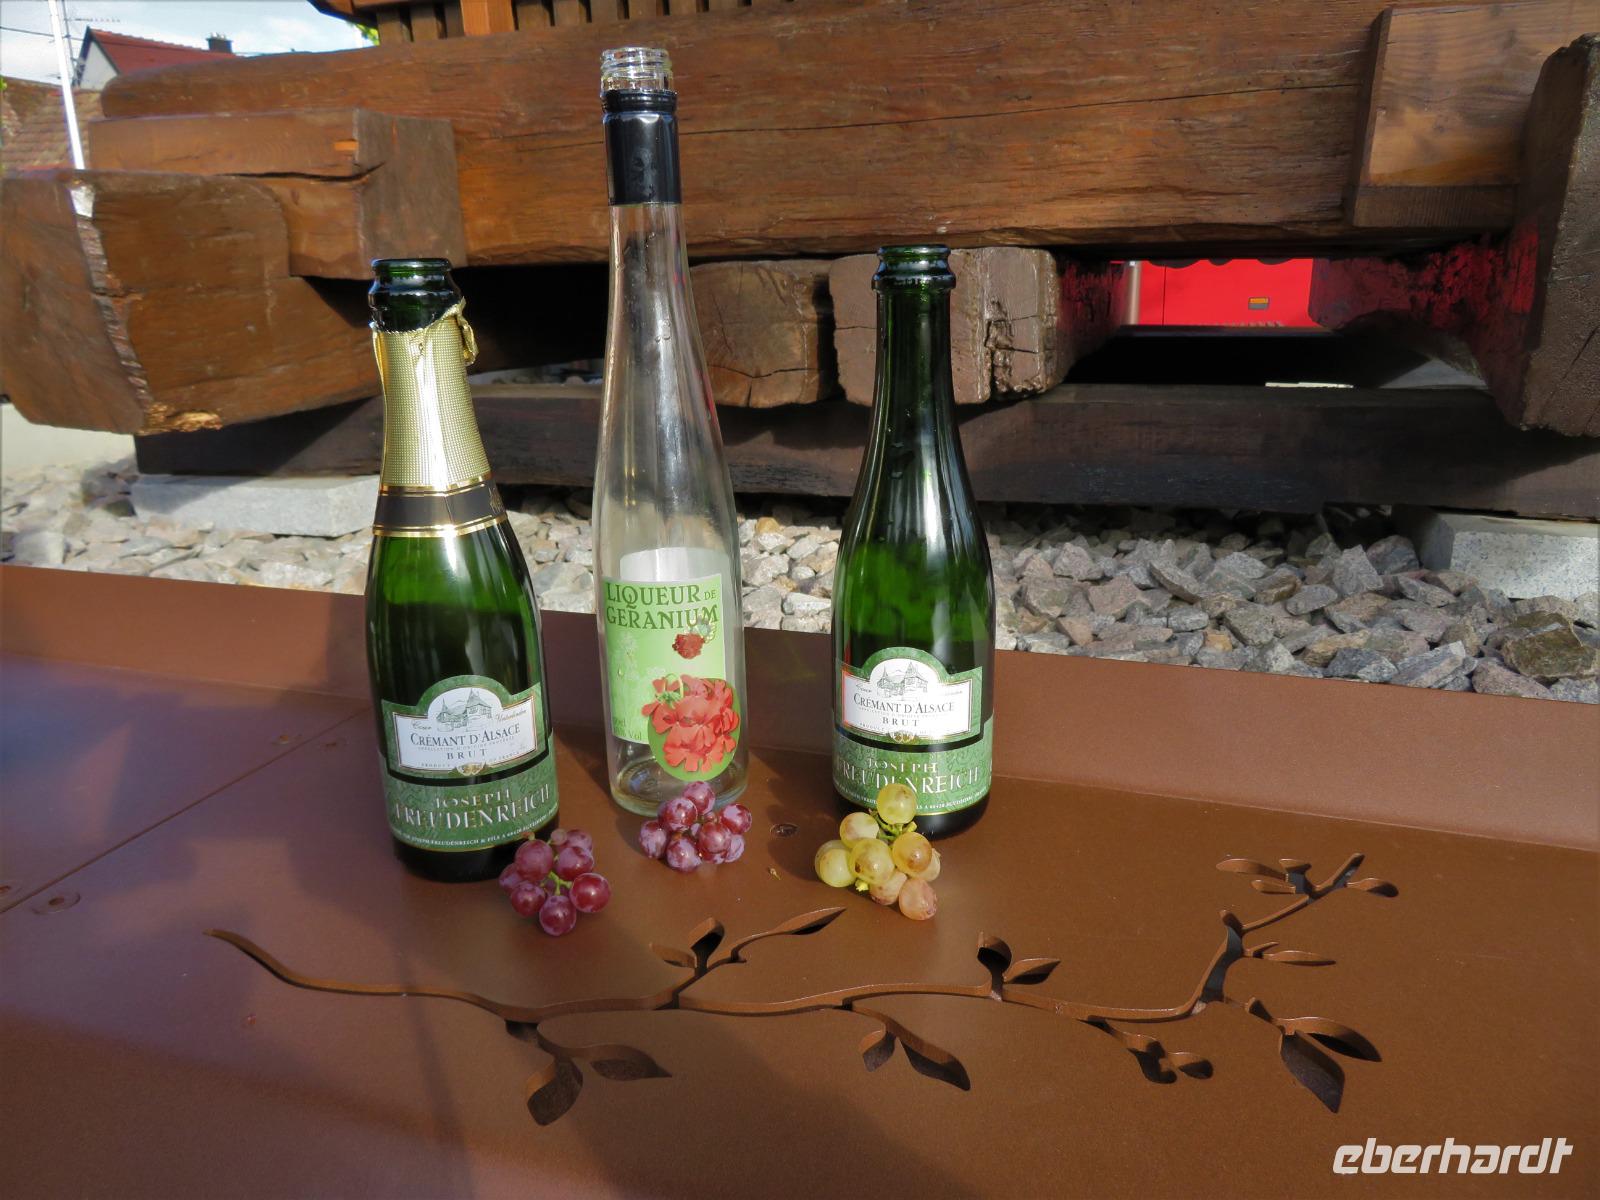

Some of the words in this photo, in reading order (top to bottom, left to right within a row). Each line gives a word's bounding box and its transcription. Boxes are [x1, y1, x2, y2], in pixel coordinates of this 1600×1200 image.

[606, 582, 702, 609] LIQUEUR
[704, 589, 716, 600] DE
[606, 604, 719, 629] GERANIUM
[853, 693, 902, 713] CRÉMANT
[882, 717, 920, 727] BRUT
[410, 733, 466, 747] CRÉMANT
[469, 724, 521, 744] D'ALSACE
[447, 748, 488, 760] BRUT
[868, 758, 938, 773] JOSEPH
[395, 783, 549, 829] FREUDENREICH
[436, 788, 510, 809] JOSEPH
